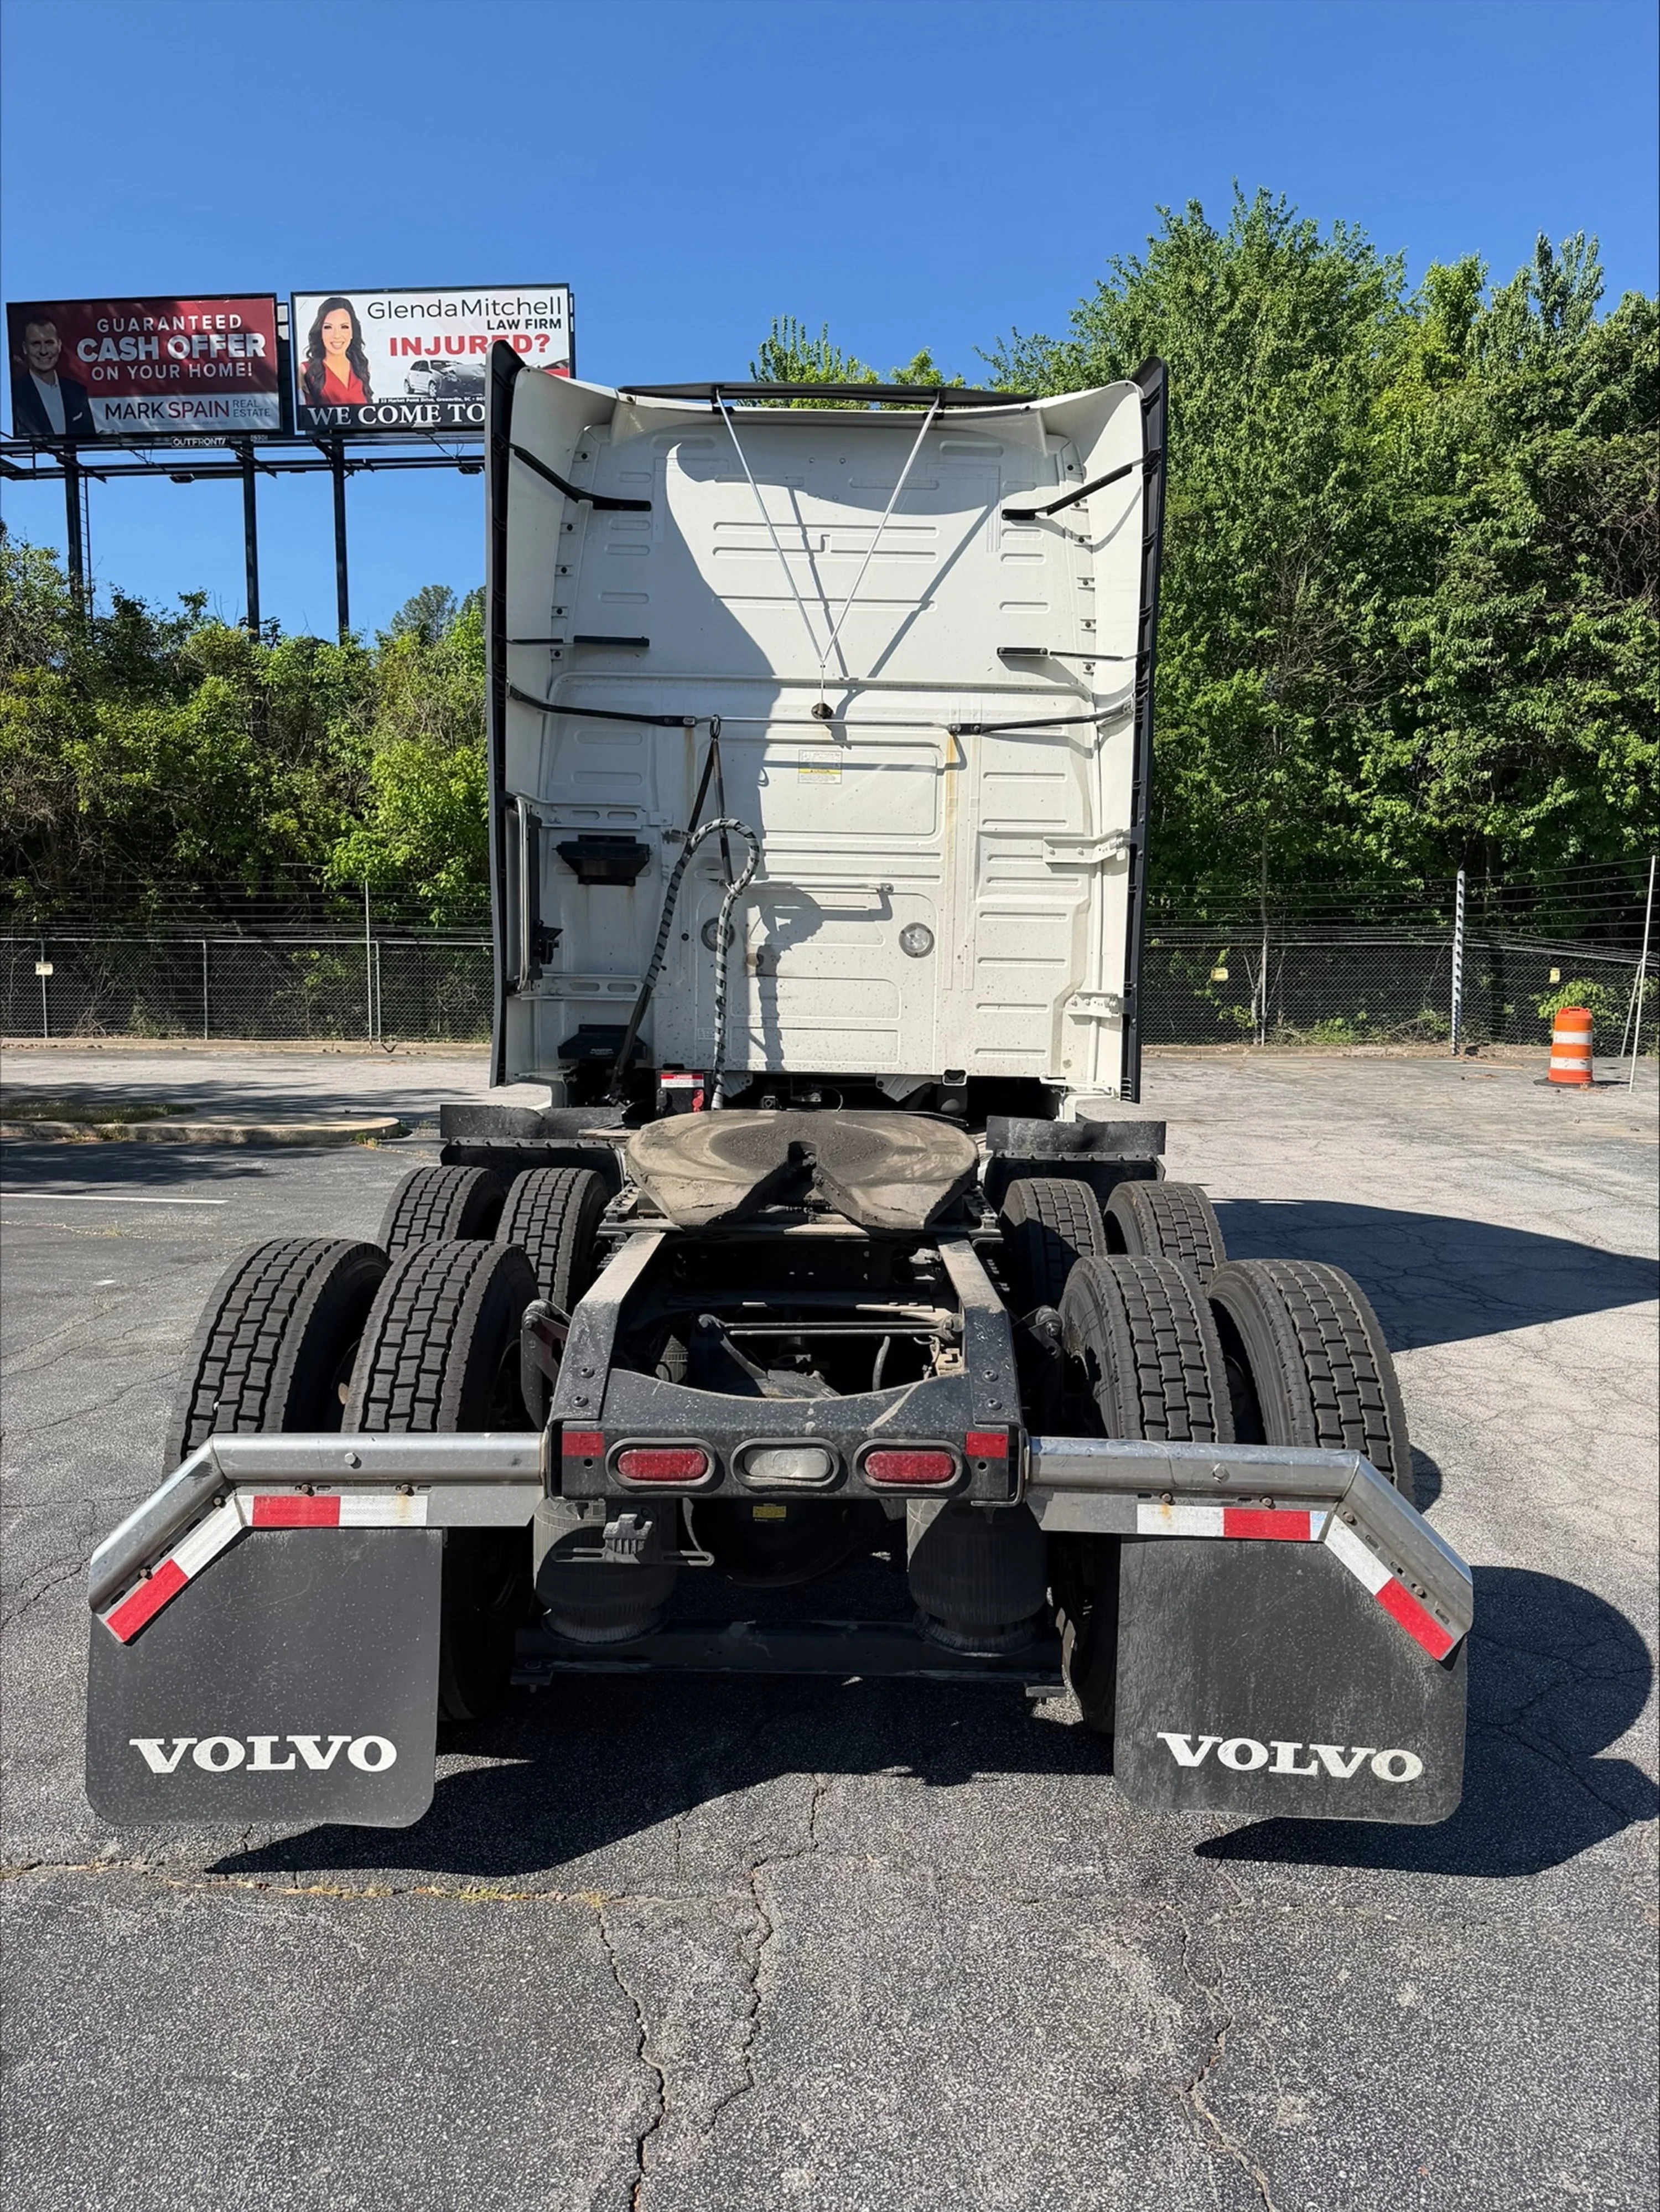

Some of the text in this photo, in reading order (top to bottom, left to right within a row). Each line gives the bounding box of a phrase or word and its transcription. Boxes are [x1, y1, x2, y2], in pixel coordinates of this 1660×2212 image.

[97, 314, 242, 332] GUARANTEED
[487, 318, 561, 330] LAW FIRM
[76, 333, 266, 362] CASH OFFER
[390, 334, 551, 356] INJURD?
[91, 362, 253, 381] ON YOUR HOME!
[105, 400, 229, 420] MARK SPAIN
[232, 400, 260, 408] REAL
[232, 408, 271, 417] ESTATE
[308, 403, 485, 426] WE COME TO
[129, 1735, 397, 1773] VOLVO
[1156, 1732, 1423, 1783] VOLVO
